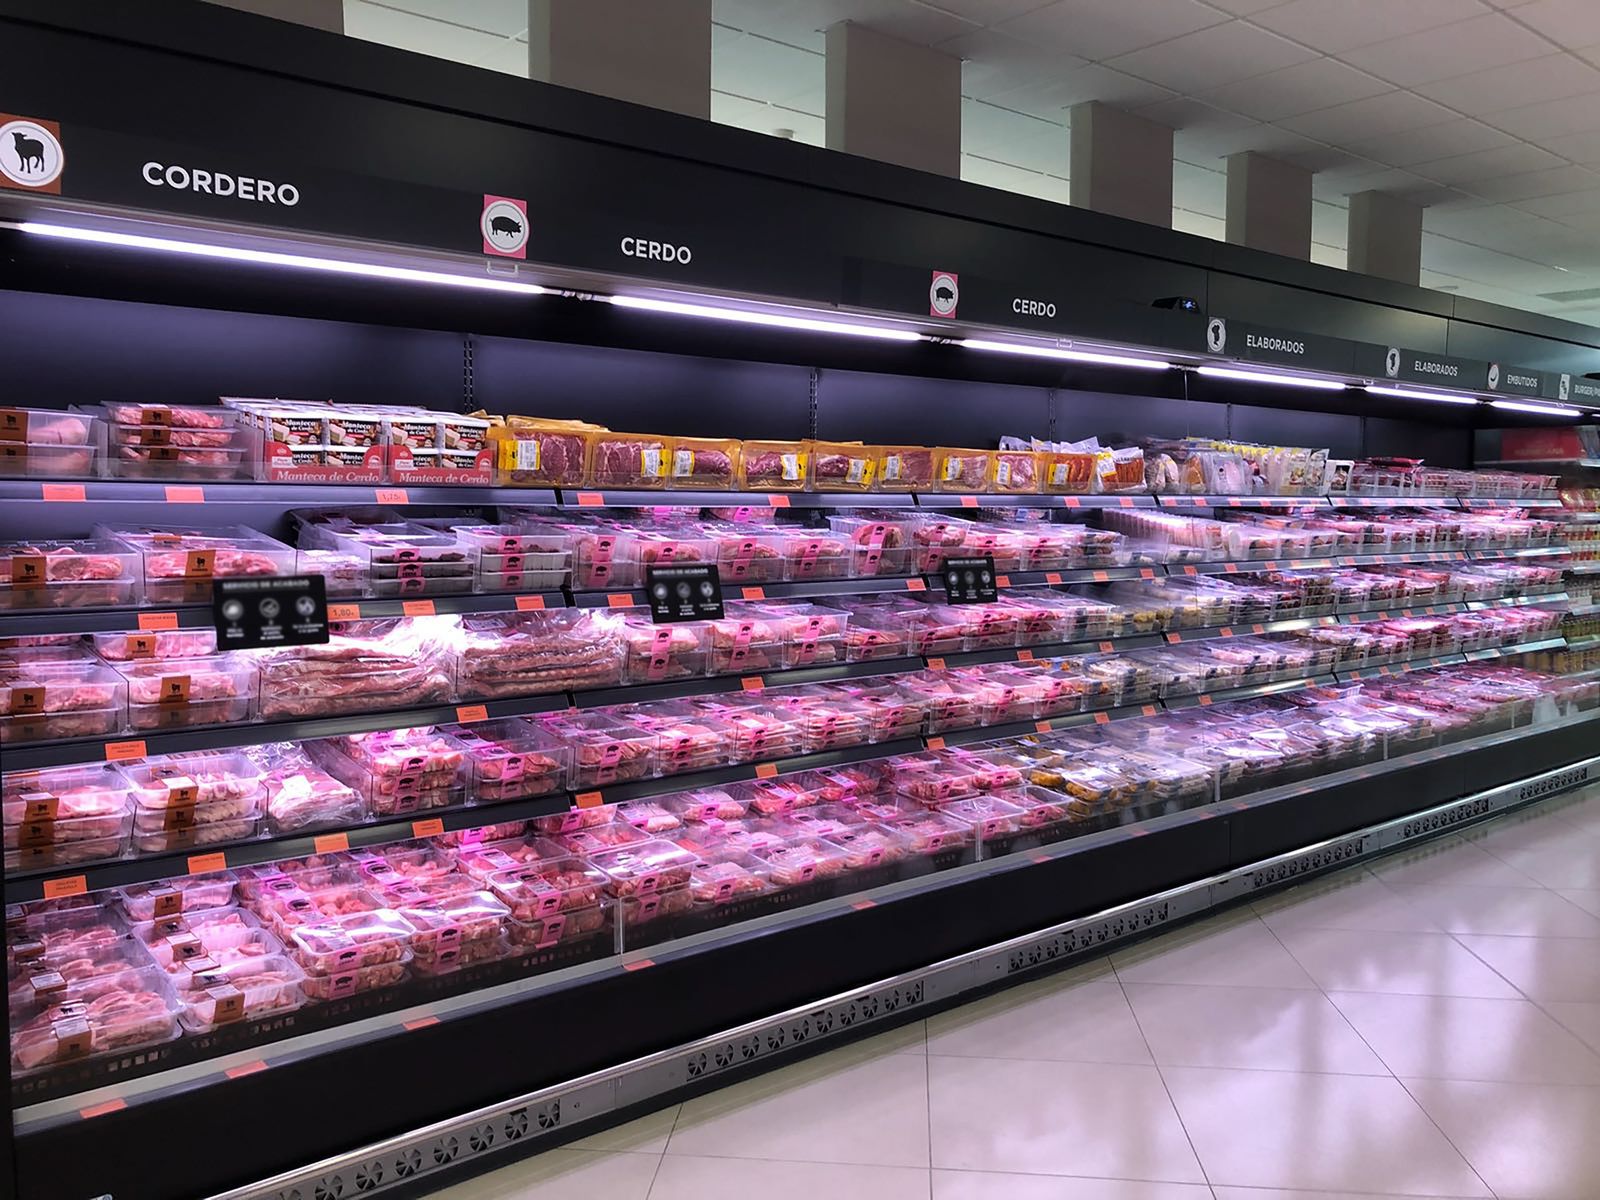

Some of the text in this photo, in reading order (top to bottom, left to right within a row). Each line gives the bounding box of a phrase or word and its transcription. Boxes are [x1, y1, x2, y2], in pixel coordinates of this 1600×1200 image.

[142, 161, 300, 206] CORDERO
[620, 237, 692, 265] CERDO
[1012, 298, 1057, 318] CERDO
[1246, 334, 1305, 354] ELABORADOS
[1414, 360, 1459, 377] ELABORADOS
[1507, 374, 1538, 388] EMBUTIDOS
[339, 421, 371, 429] Manteca
[276, 470, 380, 482] Manteca de Cerdo
[399, 472, 489, 485] Manteca de Cerdo
